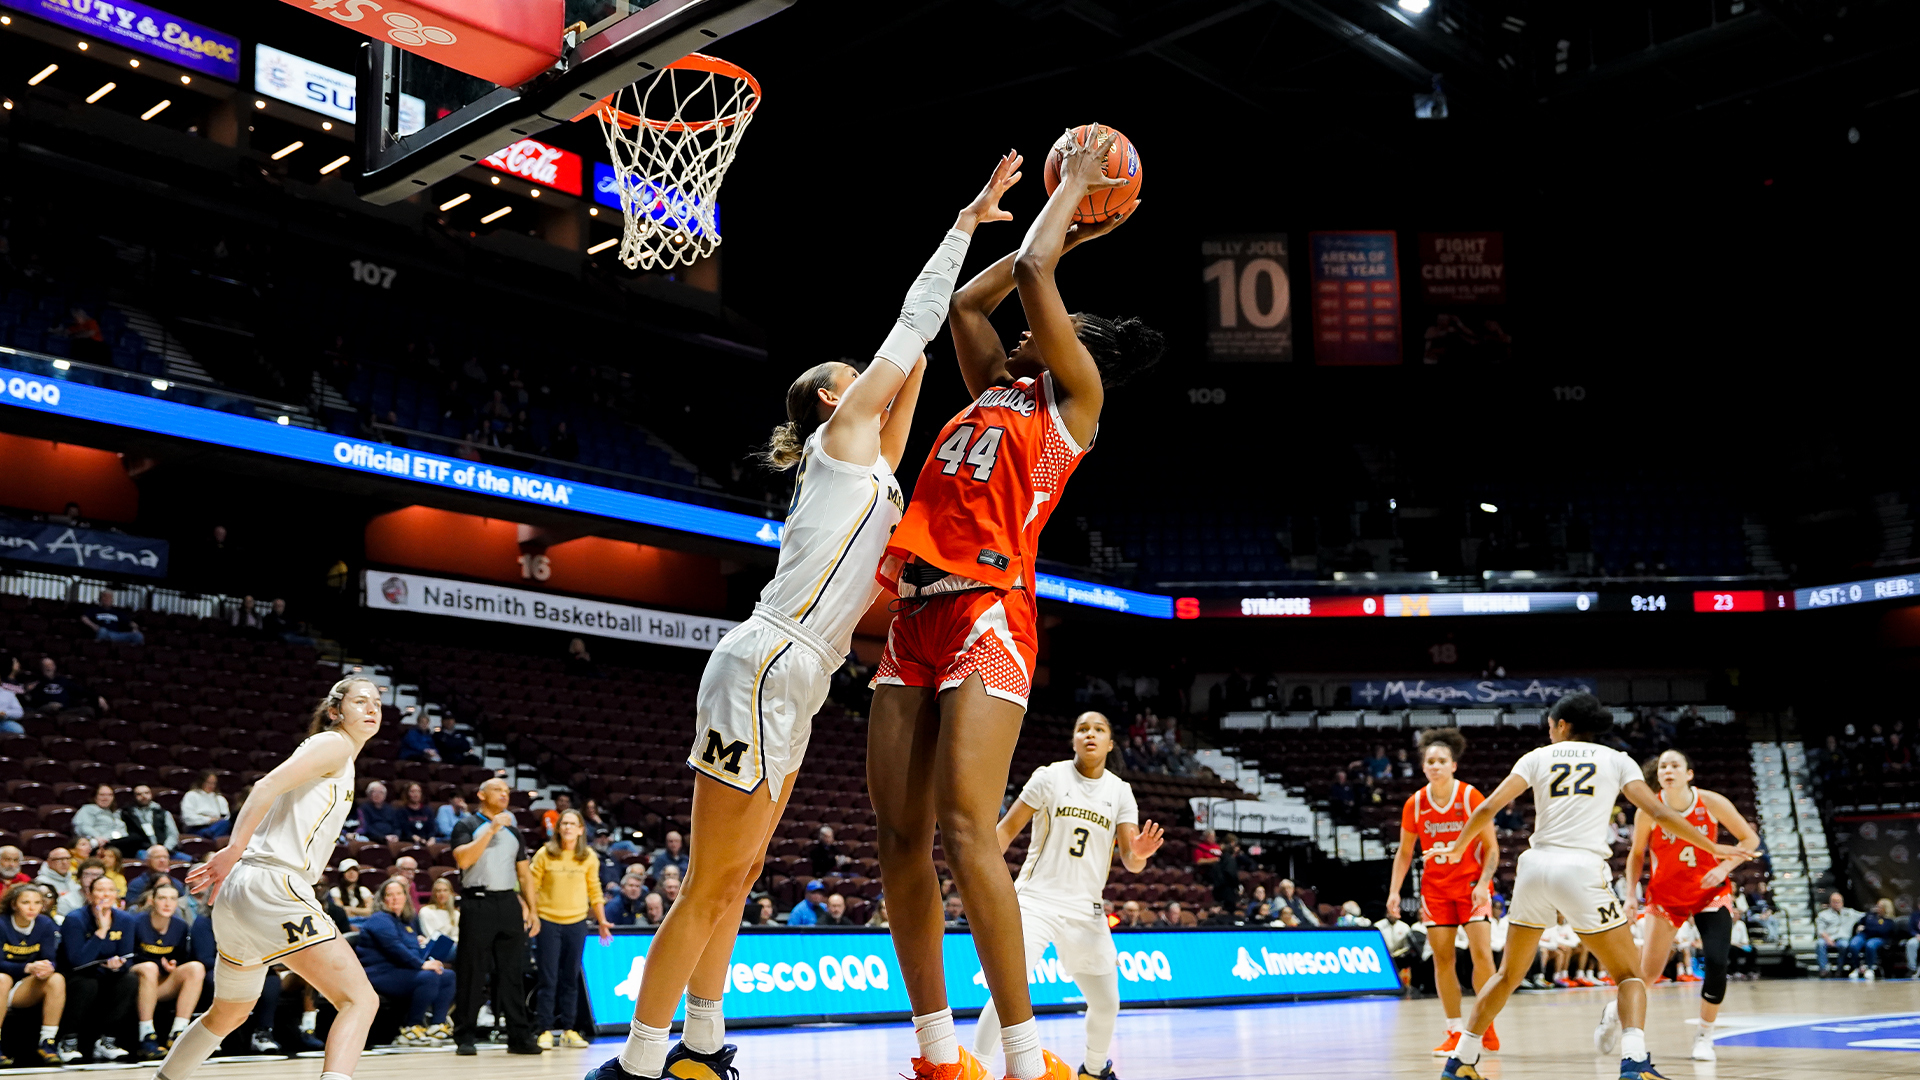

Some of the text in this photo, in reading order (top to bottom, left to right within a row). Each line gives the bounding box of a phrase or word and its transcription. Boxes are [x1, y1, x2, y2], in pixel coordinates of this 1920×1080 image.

[1201, 241, 1287, 256] BILLY JOEL
[1321, 250, 1367, 263] ARENA
[1434, 237, 1487, 254] FIGHT
[350, 259, 397, 289] 107
[1323, 263, 1387, 277] THE YEAR
[1421, 264, 1504, 280] CENTURY
[1202, 257, 1291, 329] 10
[8, 378, 60, 406] QQQ
[1188, 388, 1226, 405] 109
[934, 423, 1006, 484] 44
[333, 442, 411, 475] Official
[413, 457, 451, 482] ETF
[453, 466, 476, 487] of
[477, 469, 510, 493] the
[46, 529, 160, 568] Arena
[517, 553, 552, 582] 16
[1462, 594, 1591, 613] MICHIGAN 0
[1630, 594, 1667, 611] 9:14
[1712, 594, 1735, 611] 23
[1808, 577, 1915, 608] AST: 0 REB:
[423, 586, 527, 617] Naismith
[533, 601, 643, 634] Basketball
[648, 618, 687, 640] Hall
[691, 625, 711, 643] of
[1241, 597, 1377, 616] SYRACUSE 0
[1429, 643, 1457, 665] 18
[1382, 679, 1474, 704] Mohegan
[1476, 681, 1520, 703] Sun
[701, 727, 751, 777] M
[1552, 748, 1597, 758] DUDLEY
[1549, 762, 1597, 799] 22
[1055, 806, 1112, 832] MICHIGAN
[1069, 826, 1090, 858] 3
[1678, 845, 1698, 868] 4
[1597, 901, 1620, 925] M
[282, 915, 318, 944] M
[818, 954, 890, 993] QQQ
[1117, 950, 1173, 982] QQQ
[1261, 946, 1382, 976] Invesco QQQ
